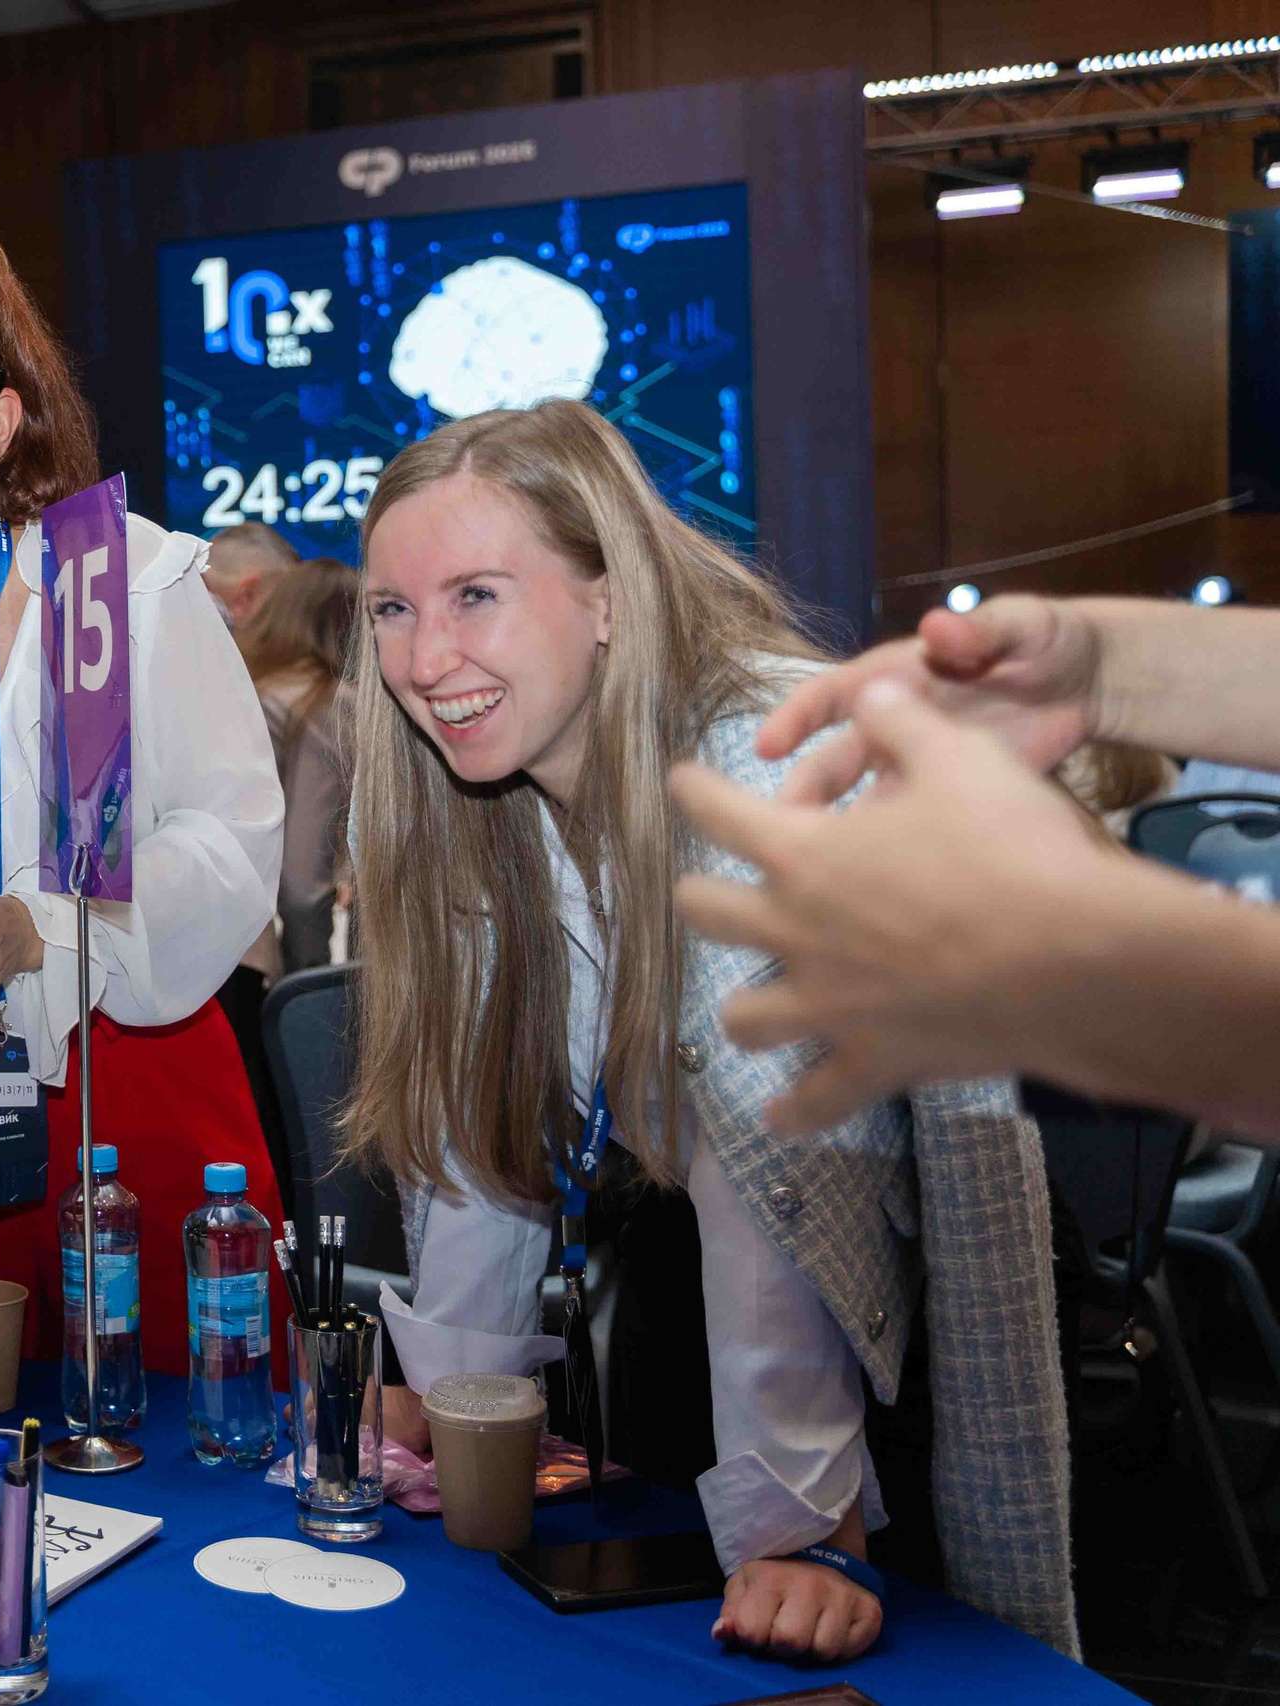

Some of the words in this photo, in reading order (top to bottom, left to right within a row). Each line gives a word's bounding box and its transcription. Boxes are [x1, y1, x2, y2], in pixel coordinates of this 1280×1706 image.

[202, 456, 384, 527] 24:25
[53, 545, 113, 694] 15
[228, 1556, 268, 1567] NTHIA
[824, 1551, 847, 1566] CAN
[292, 1574, 374, 1585] CORINTHIA
